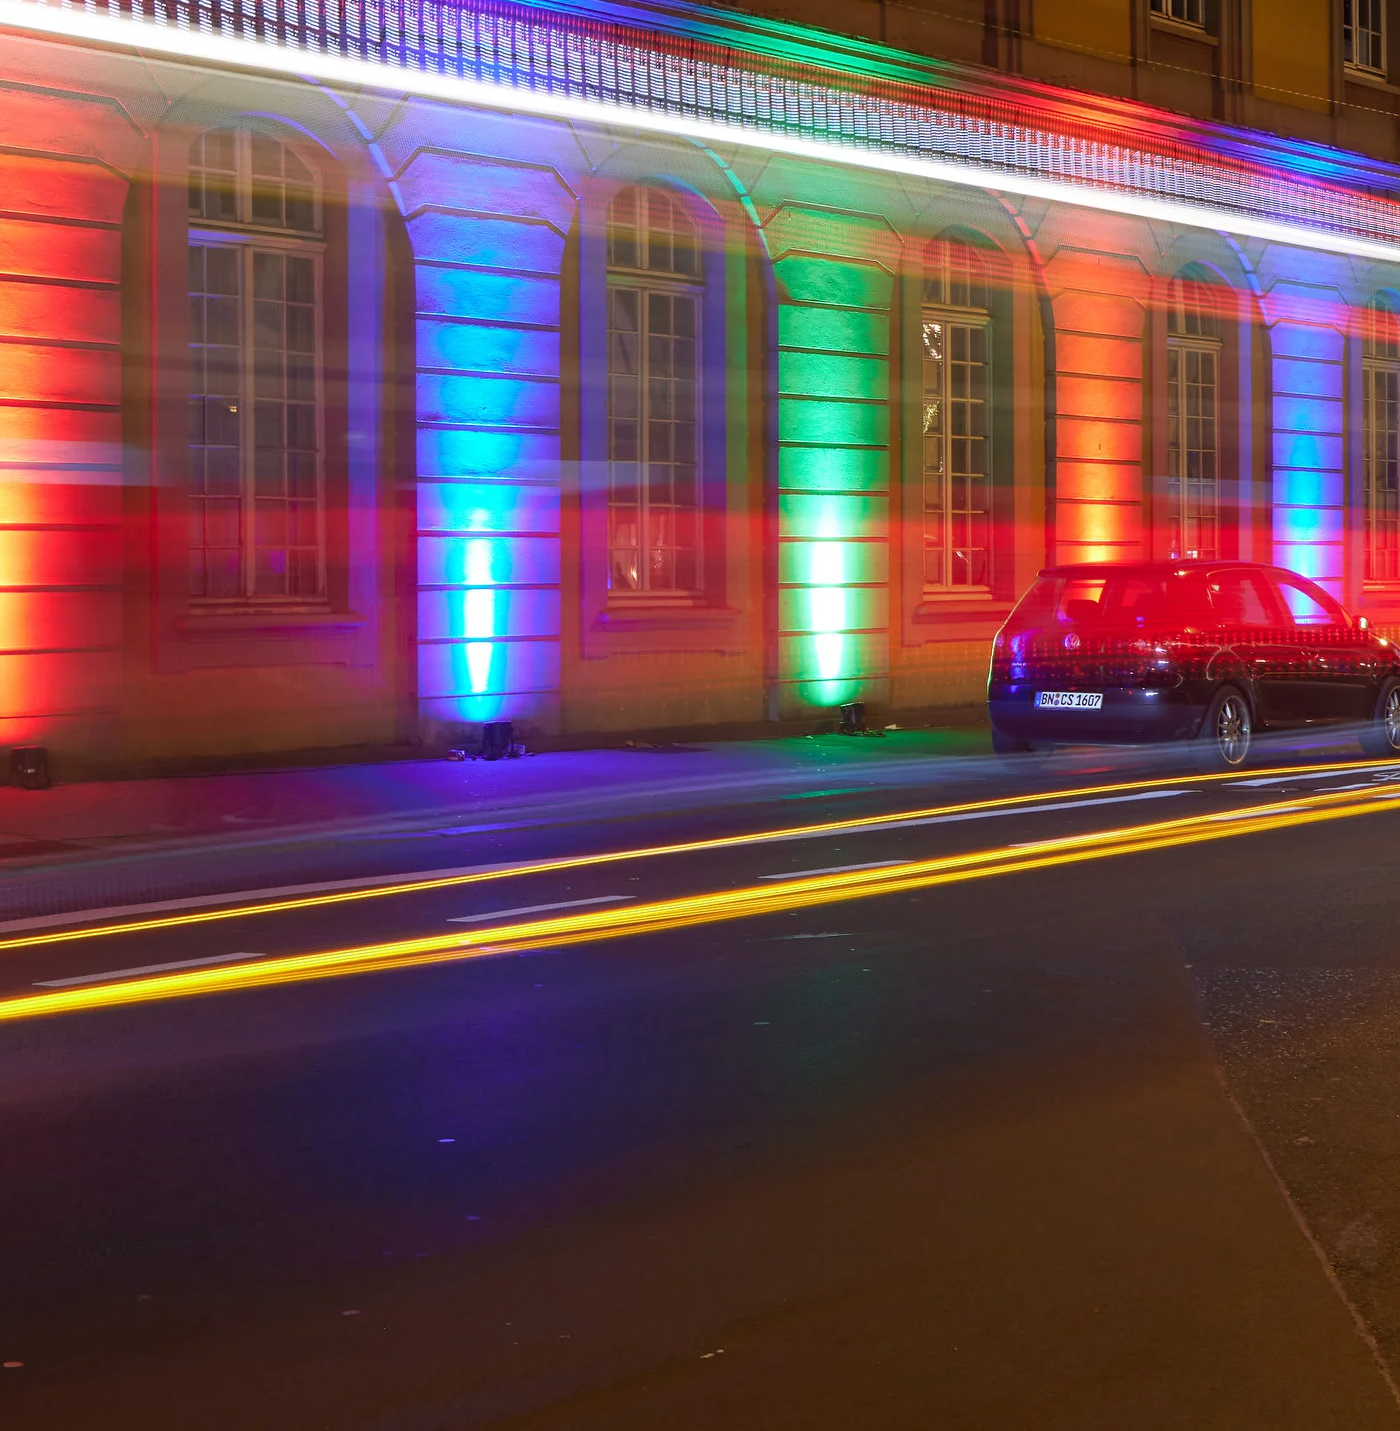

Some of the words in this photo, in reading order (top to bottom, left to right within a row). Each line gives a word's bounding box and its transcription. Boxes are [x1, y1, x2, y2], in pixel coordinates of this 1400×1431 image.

[1041, 693, 1055, 705] BN
[1061, 694, 1074, 706] CS
[1075, 694, 1101, 707] 1607
